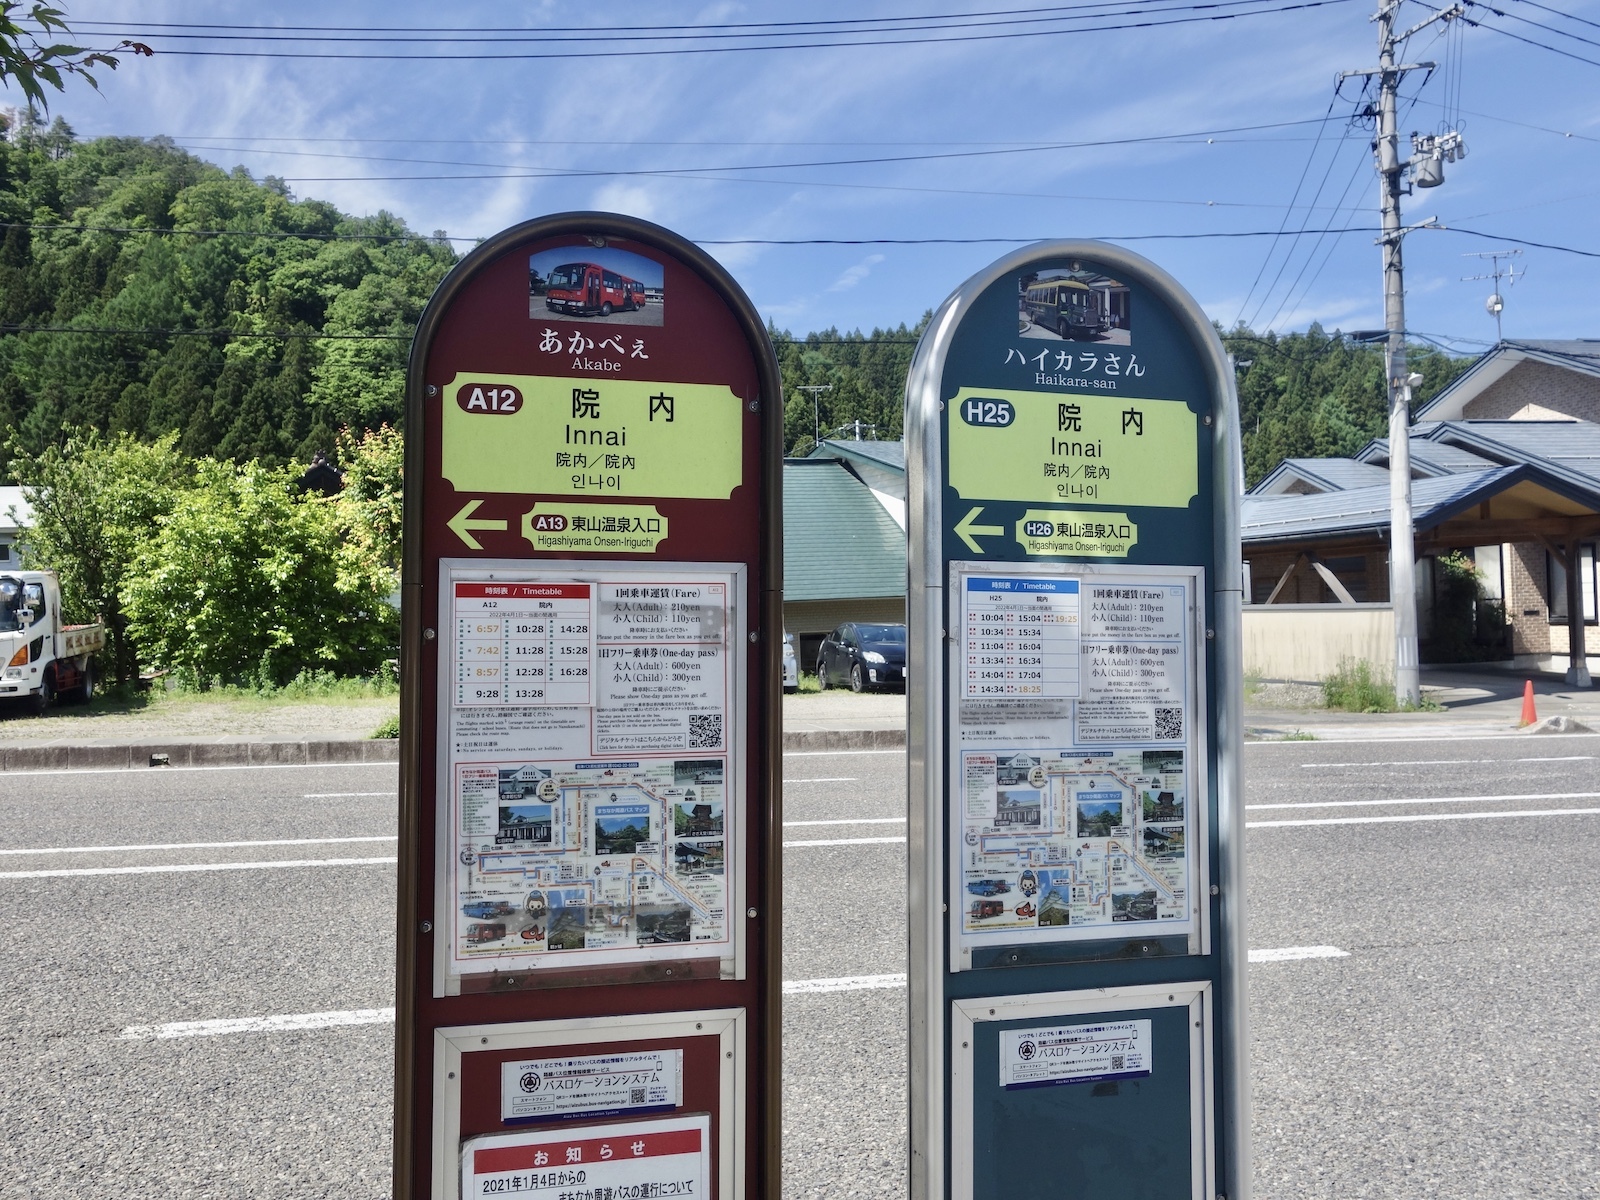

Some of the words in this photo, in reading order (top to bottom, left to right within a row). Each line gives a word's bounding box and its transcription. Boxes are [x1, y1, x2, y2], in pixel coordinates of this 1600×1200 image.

[539, 328, 649, 360] あかべぇ
[572, 358, 621, 372] Akabe
[1004, 348, 1146, 377] ハイカラさん
[1035, 372, 1116, 389] Haikara-san
[467, 388, 516, 412] A12
[967, 402, 1010, 424] H25
[566, 425, 626, 446] Innai
[1051, 437, 1102, 458] Innai
[572, 475, 621, 490] 인나이
[1057, 484, 1098, 498] 인나이
[536, 517, 564, 530] A13
[572, 516, 660, 533] 東山温泉入口
[1027, 523, 1050, 536] H26
[1057, 523, 1130, 539] 東山温泉入口
[538, 535, 592, 548] Higashiyama
[594, 536, 653, 549] Onsen-Iriguchi
[1029, 540, 1073, 552] Higashiyama
[1075, 541, 1124, 554] Onsen-Iriguchi
[698, 648, 718, 658] pass)
[1162, 646, 1179, 655] pass)
[1038, 1041, 1136, 1058] バスロケーションシステム
[544, 1072, 659, 1090] バスロケーションシステム
[534, 1141, 646, 1166] お知らせ
[483, 1170, 586, 1192] 2021年1月4日からの
